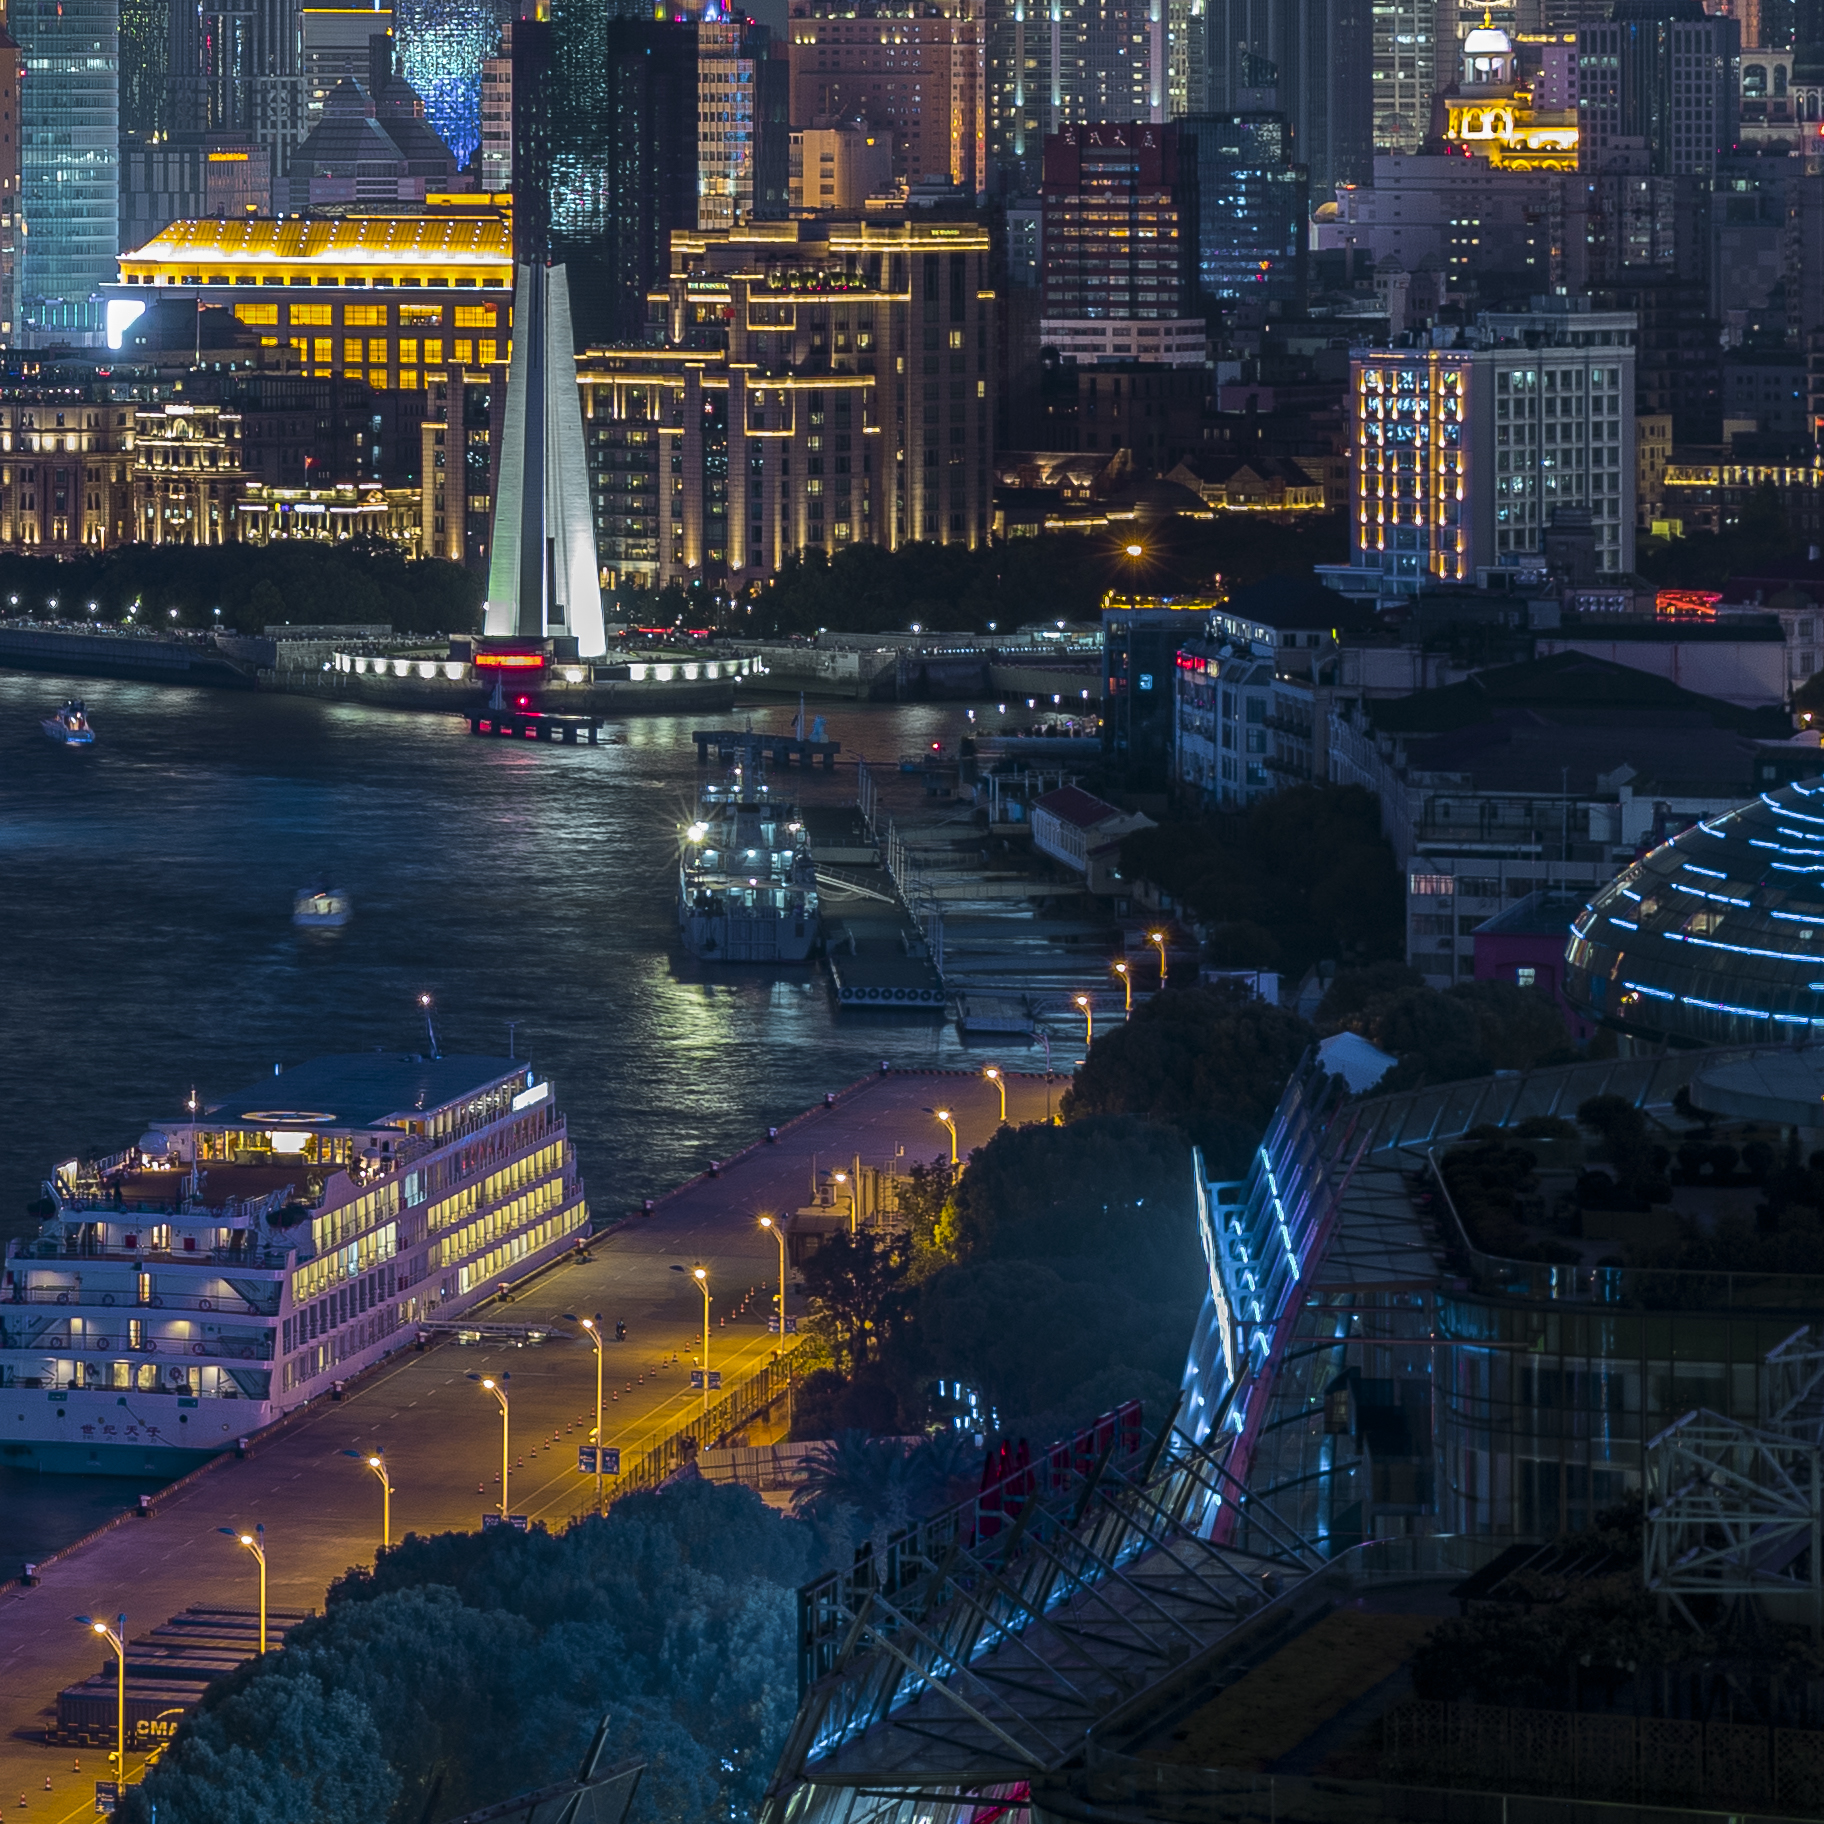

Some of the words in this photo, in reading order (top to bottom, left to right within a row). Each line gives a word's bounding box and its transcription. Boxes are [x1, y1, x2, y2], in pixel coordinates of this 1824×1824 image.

[81, 1424, 161, 1438] 世纪天子
[136, 1720, 178, 1736] CMA
